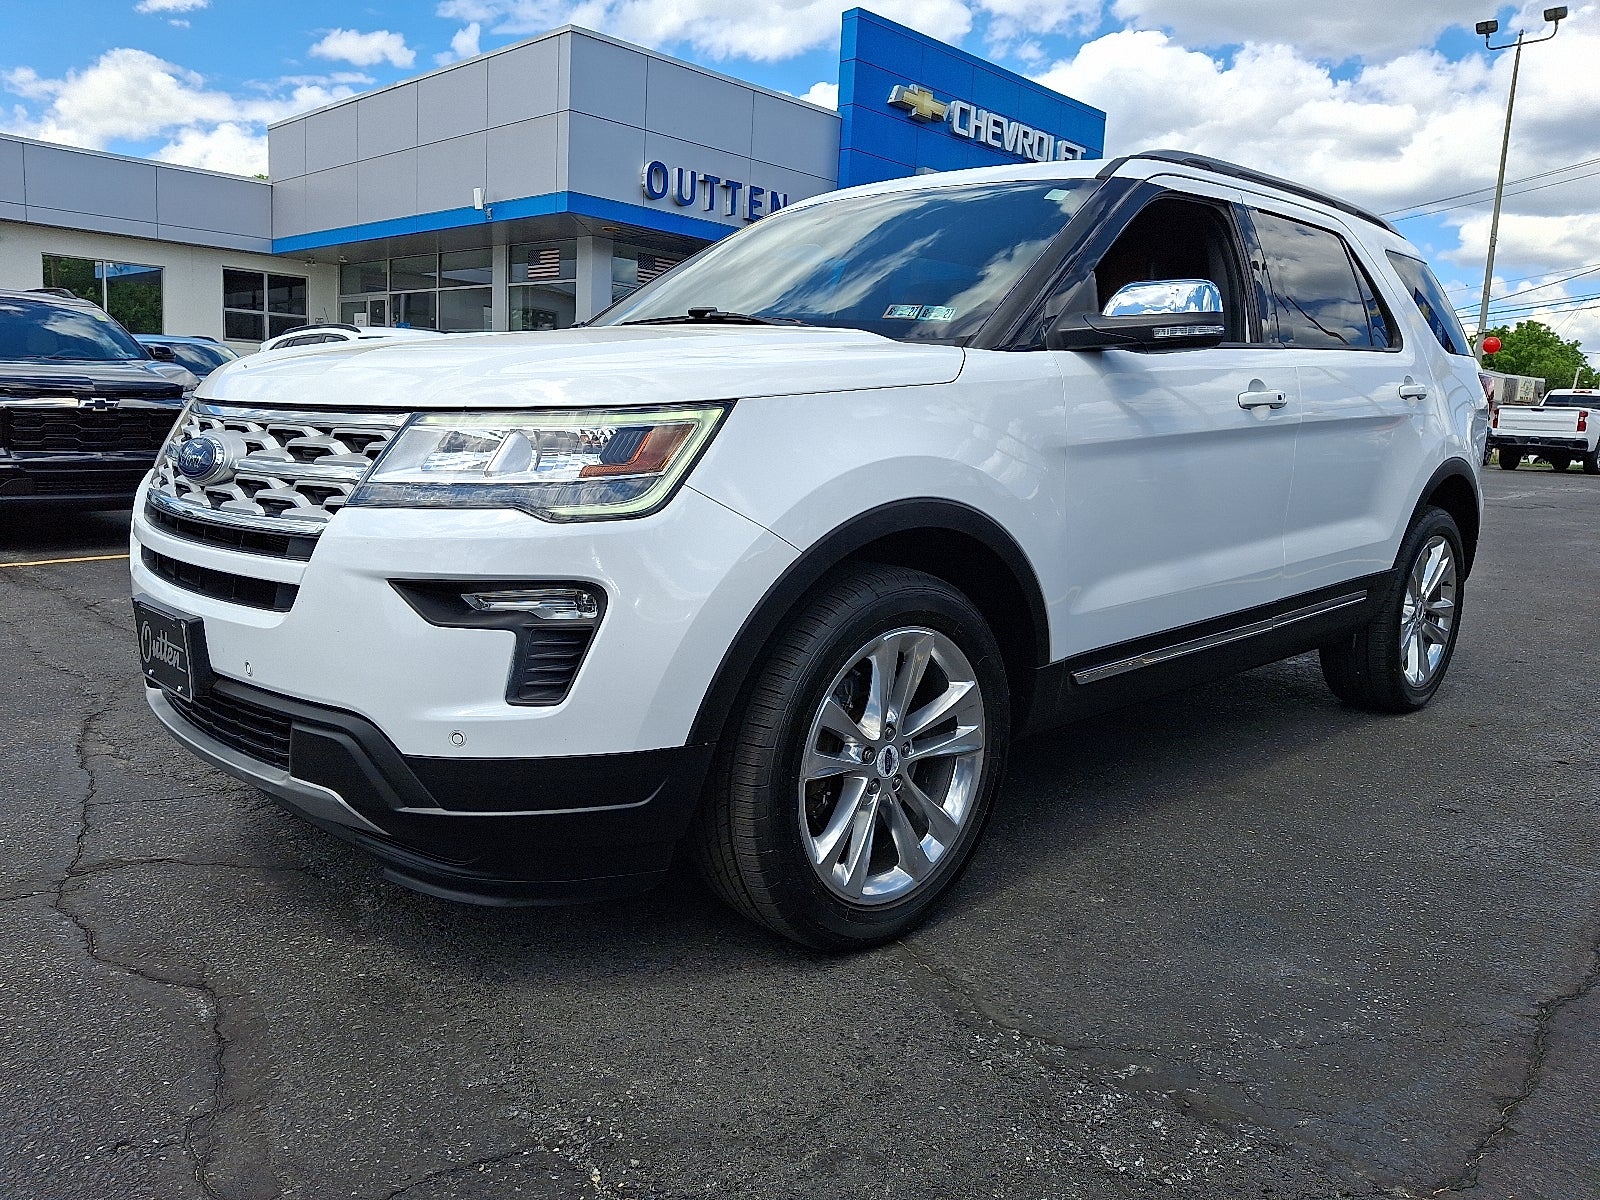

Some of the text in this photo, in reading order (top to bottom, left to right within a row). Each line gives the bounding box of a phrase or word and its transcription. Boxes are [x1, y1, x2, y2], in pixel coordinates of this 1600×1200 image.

[950, 100, 1086, 162] CHEVROLET
[642, 160, 788, 223] OUTTEN
[141, 620, 187, 673] Outten
